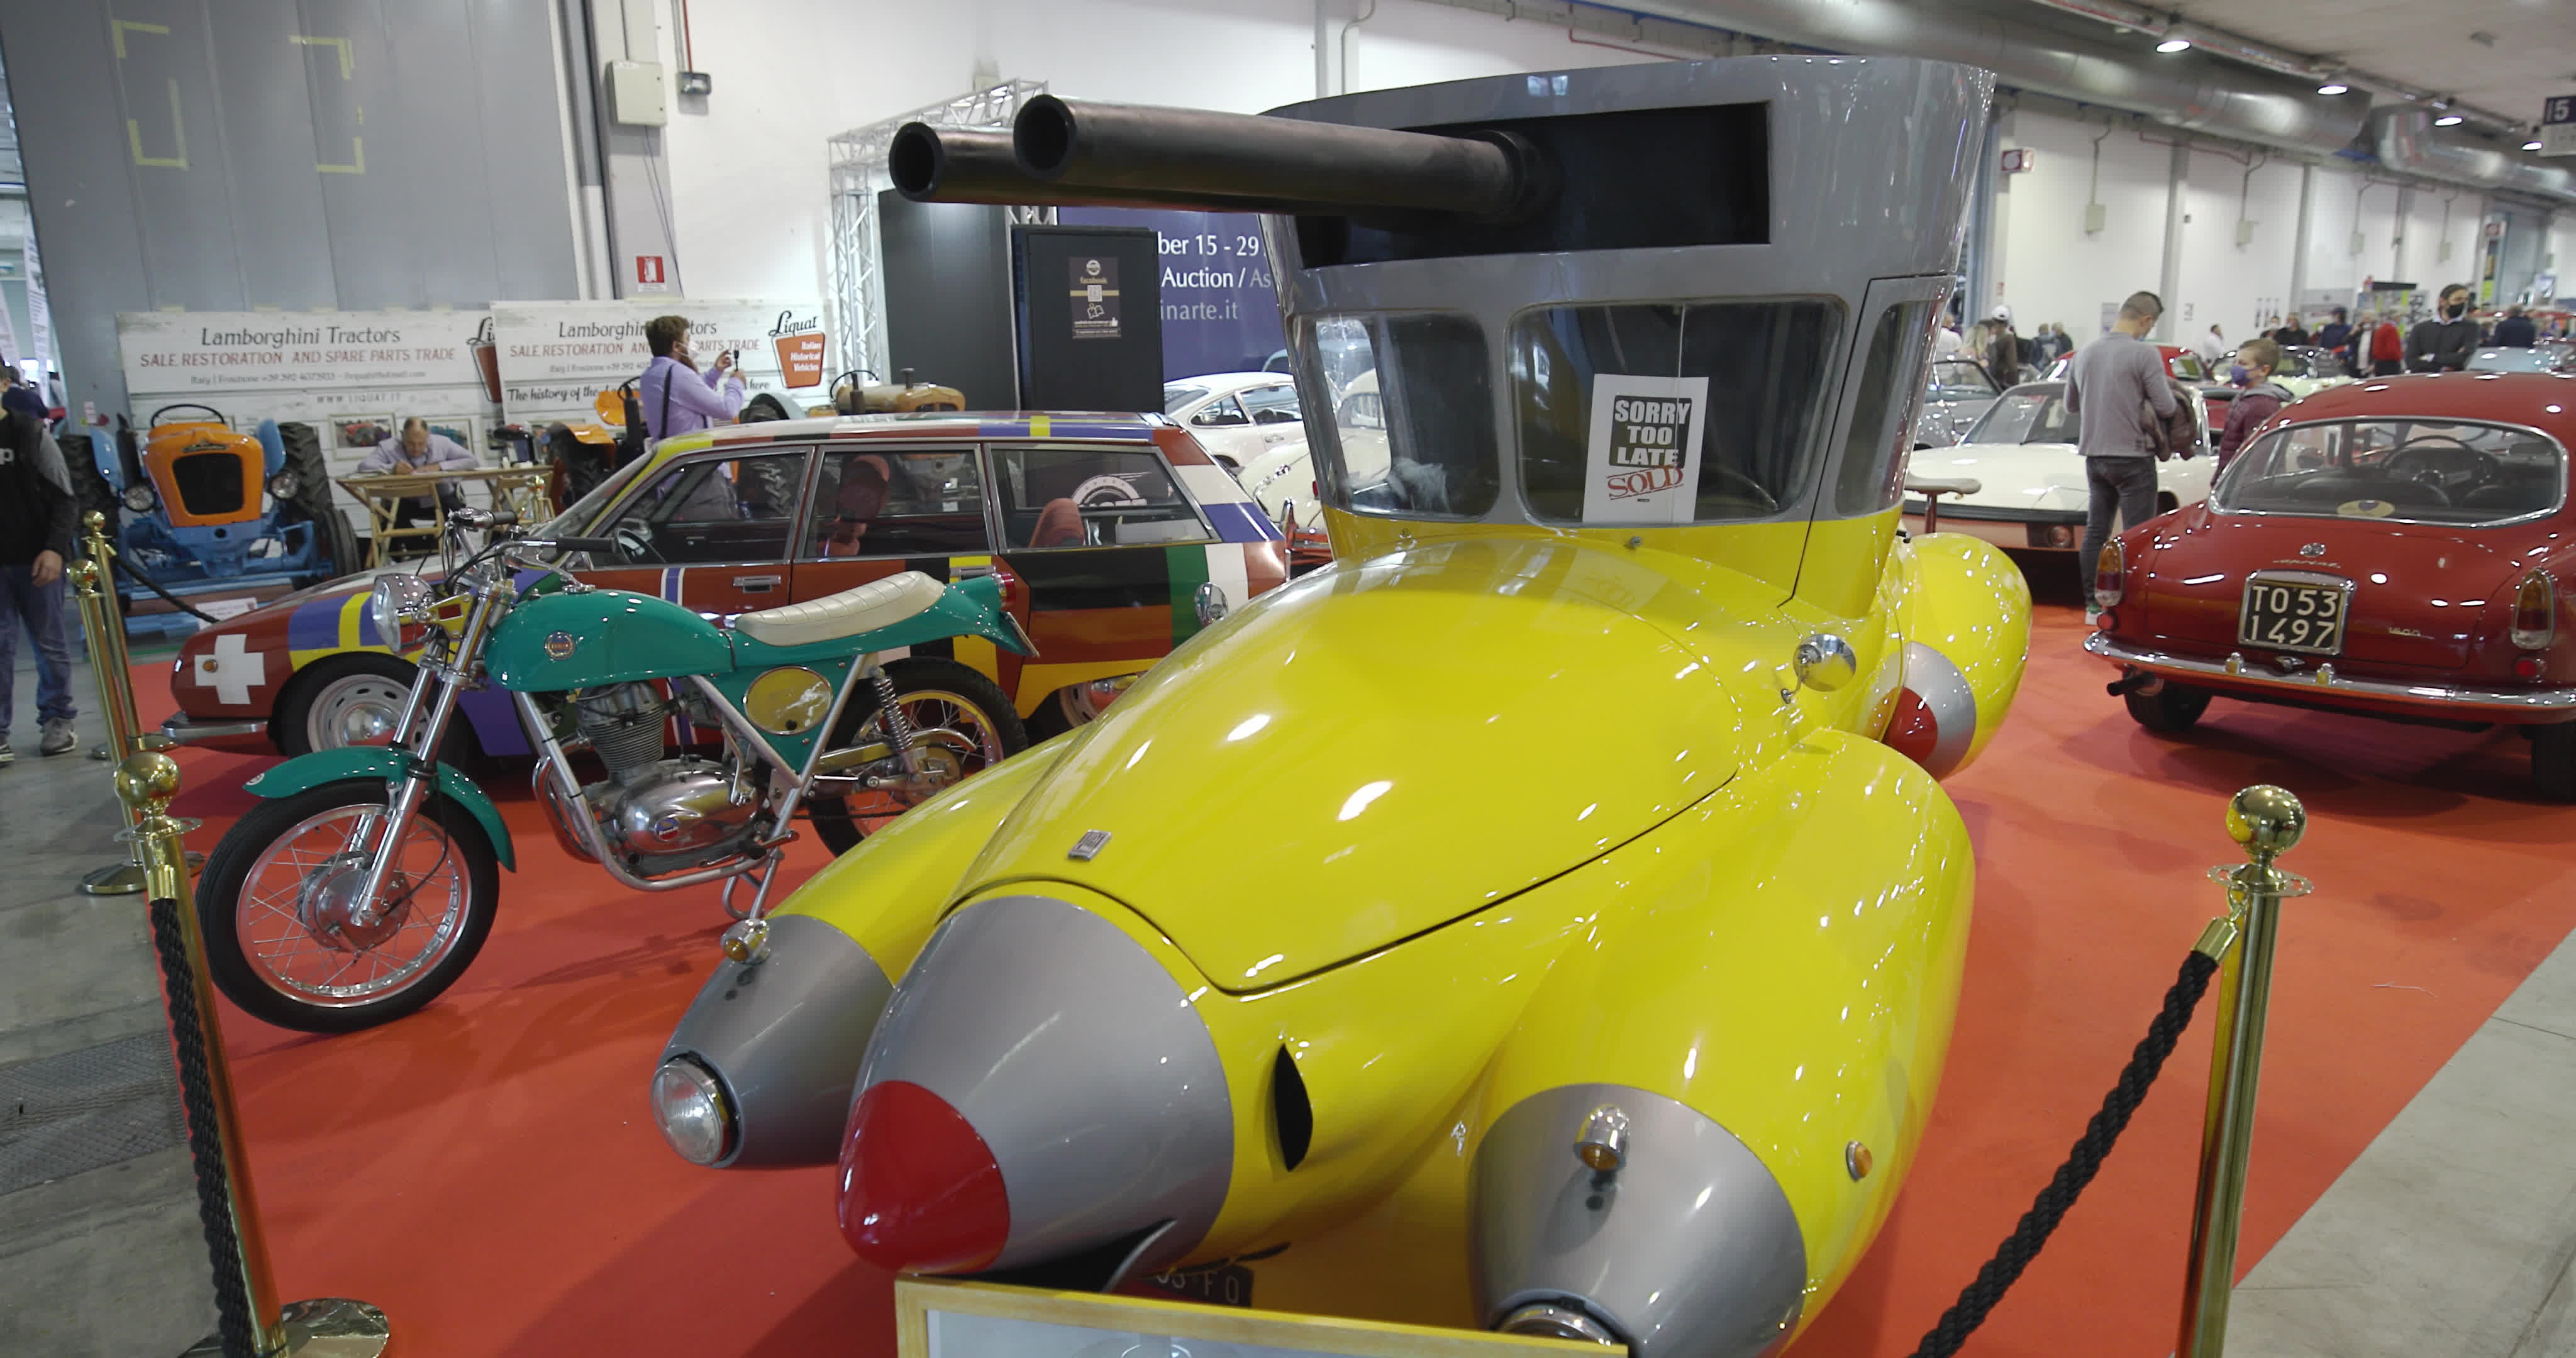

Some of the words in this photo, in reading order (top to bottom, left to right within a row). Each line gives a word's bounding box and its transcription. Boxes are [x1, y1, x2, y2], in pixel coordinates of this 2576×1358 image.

[1157, 231, 1189, 255] ber
[1195, 234, 1217, 255] 15
[1236, 235, 1259, 257] 29
[1161, 266, 1233, 287] Auction
[1249, 268, 1272, 287] As
[1160, 299, 1238, 321] inarte.it
[768, 310, 818, 338] Liquat
[201, 327, 320, 348] Lamborghini
[326, 326, 401, 344] Tractors
[543, 343, 623, 357] RESTORATION
[728, 339, 760, 351] TRADE
[182, 351, 282, 367] RESTORATION
[292, 350, 321, 364] AND
[326, 350, 365, 363] SPARE
[370, 348, 409, 362] PARTS
[415, 348, 455, 361] TRADE
[507, 389, 528, 401] The
[530, 388, 567, 401] history
[570, 387, 580, 401] of
[1614, 399, 1690, 424] SORRY
[1627, 425, 1673, 446] TOO
[1616, 446, 1679, 466] LATE
[1607, 466, 1684, 497] SOLD
[2297, 589, 2339, 617] 53
[2251, 615, 2336, 648] 1497
